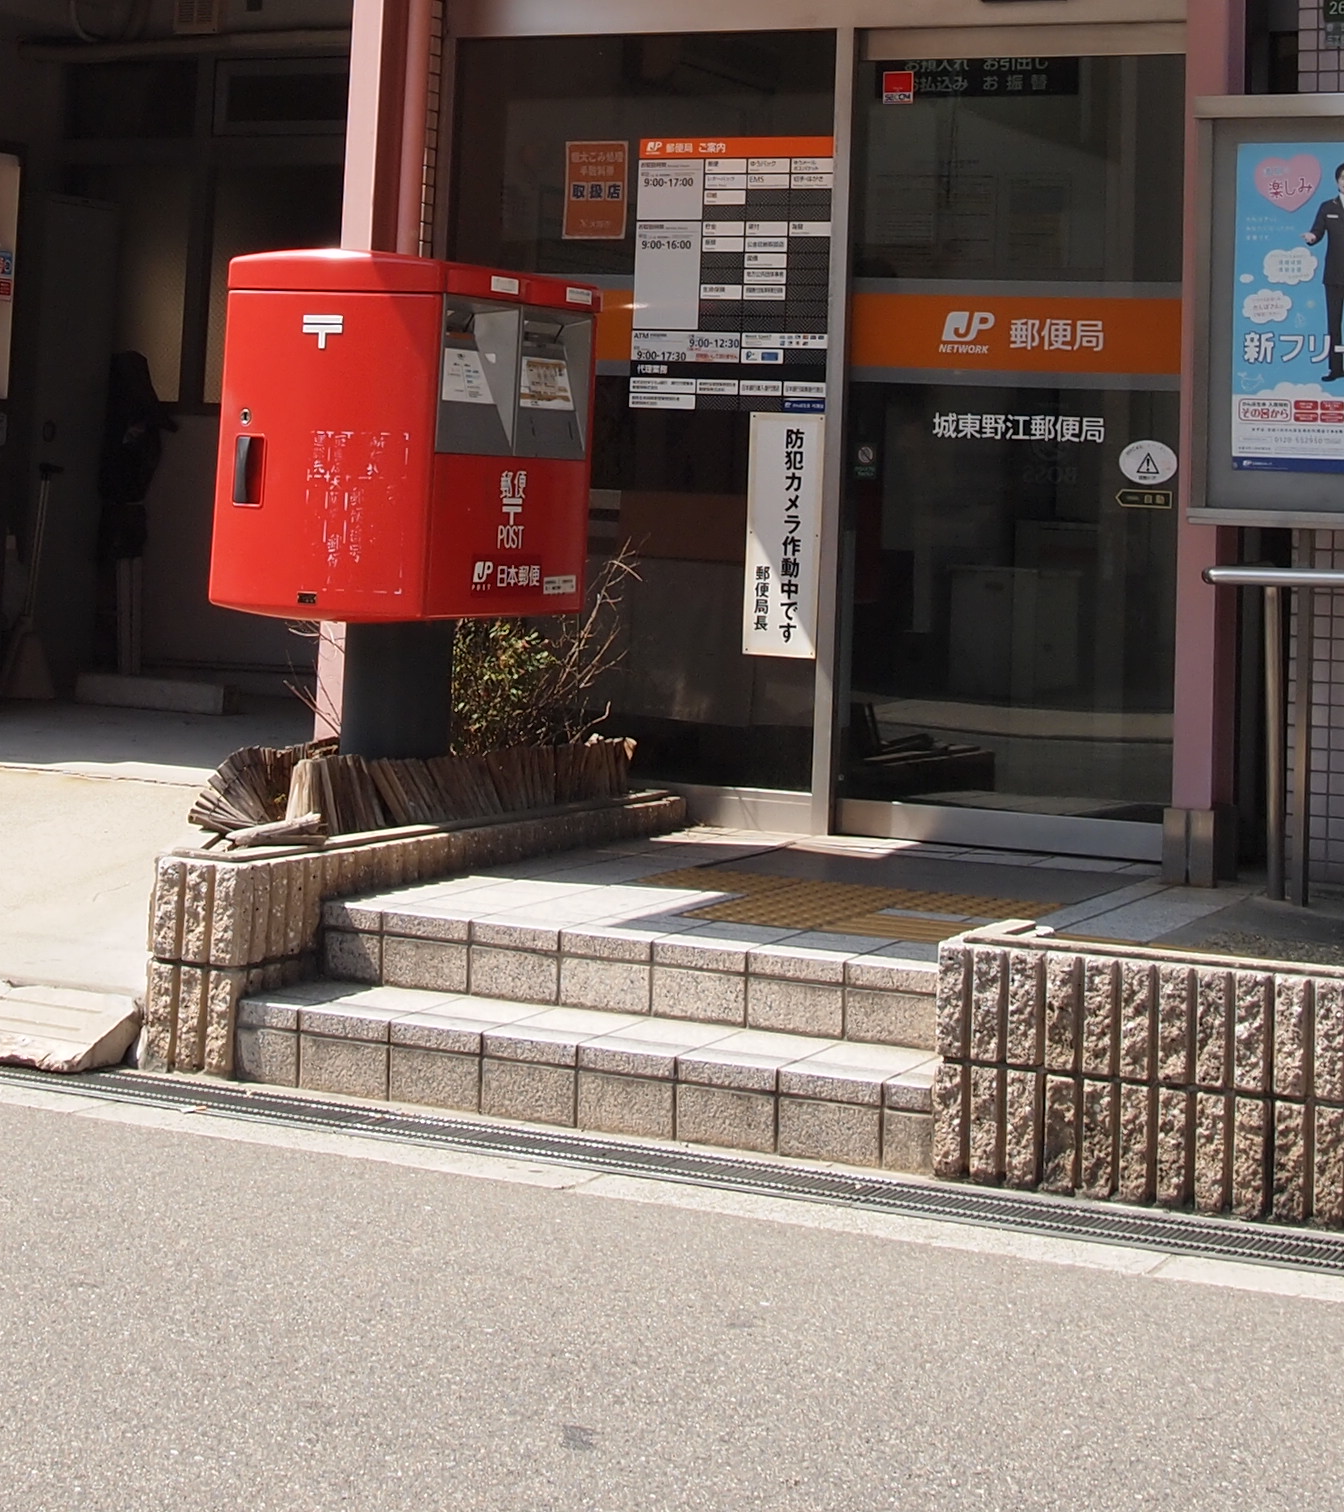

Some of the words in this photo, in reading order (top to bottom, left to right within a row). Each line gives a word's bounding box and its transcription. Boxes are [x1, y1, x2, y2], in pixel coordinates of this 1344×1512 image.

[698, 142, 726, 154] ご案内
[573, 183, 621, 199] 取扱店
[644, 177, 694, 187] 9:00-17:00
[1268, 177, 1313, 199] 楽しみ
[641, 240, 692, 250] 9:00-16:00
[941, 311, 995, 341] JP
[1010, 318, 1104, 352] 郵便局
[689, 338, 740, 348] 9:00-12:30
[938, 343, 990, 355] NETWORK
[636, 350, 687, 361] 9:00-17:30
[932, 412, 1105, 443] 城東野江郵便局
[499, 470, 527, 498] 郵便
[497, 525, 525, 549] POST
[778, 428, 806, 643] 防犯カメラ作動中です
[472, 561, 494, 583] JP
[497, 565, 541, 587] 日本郵便
[753, 565, 771, 632] 郵便局長
